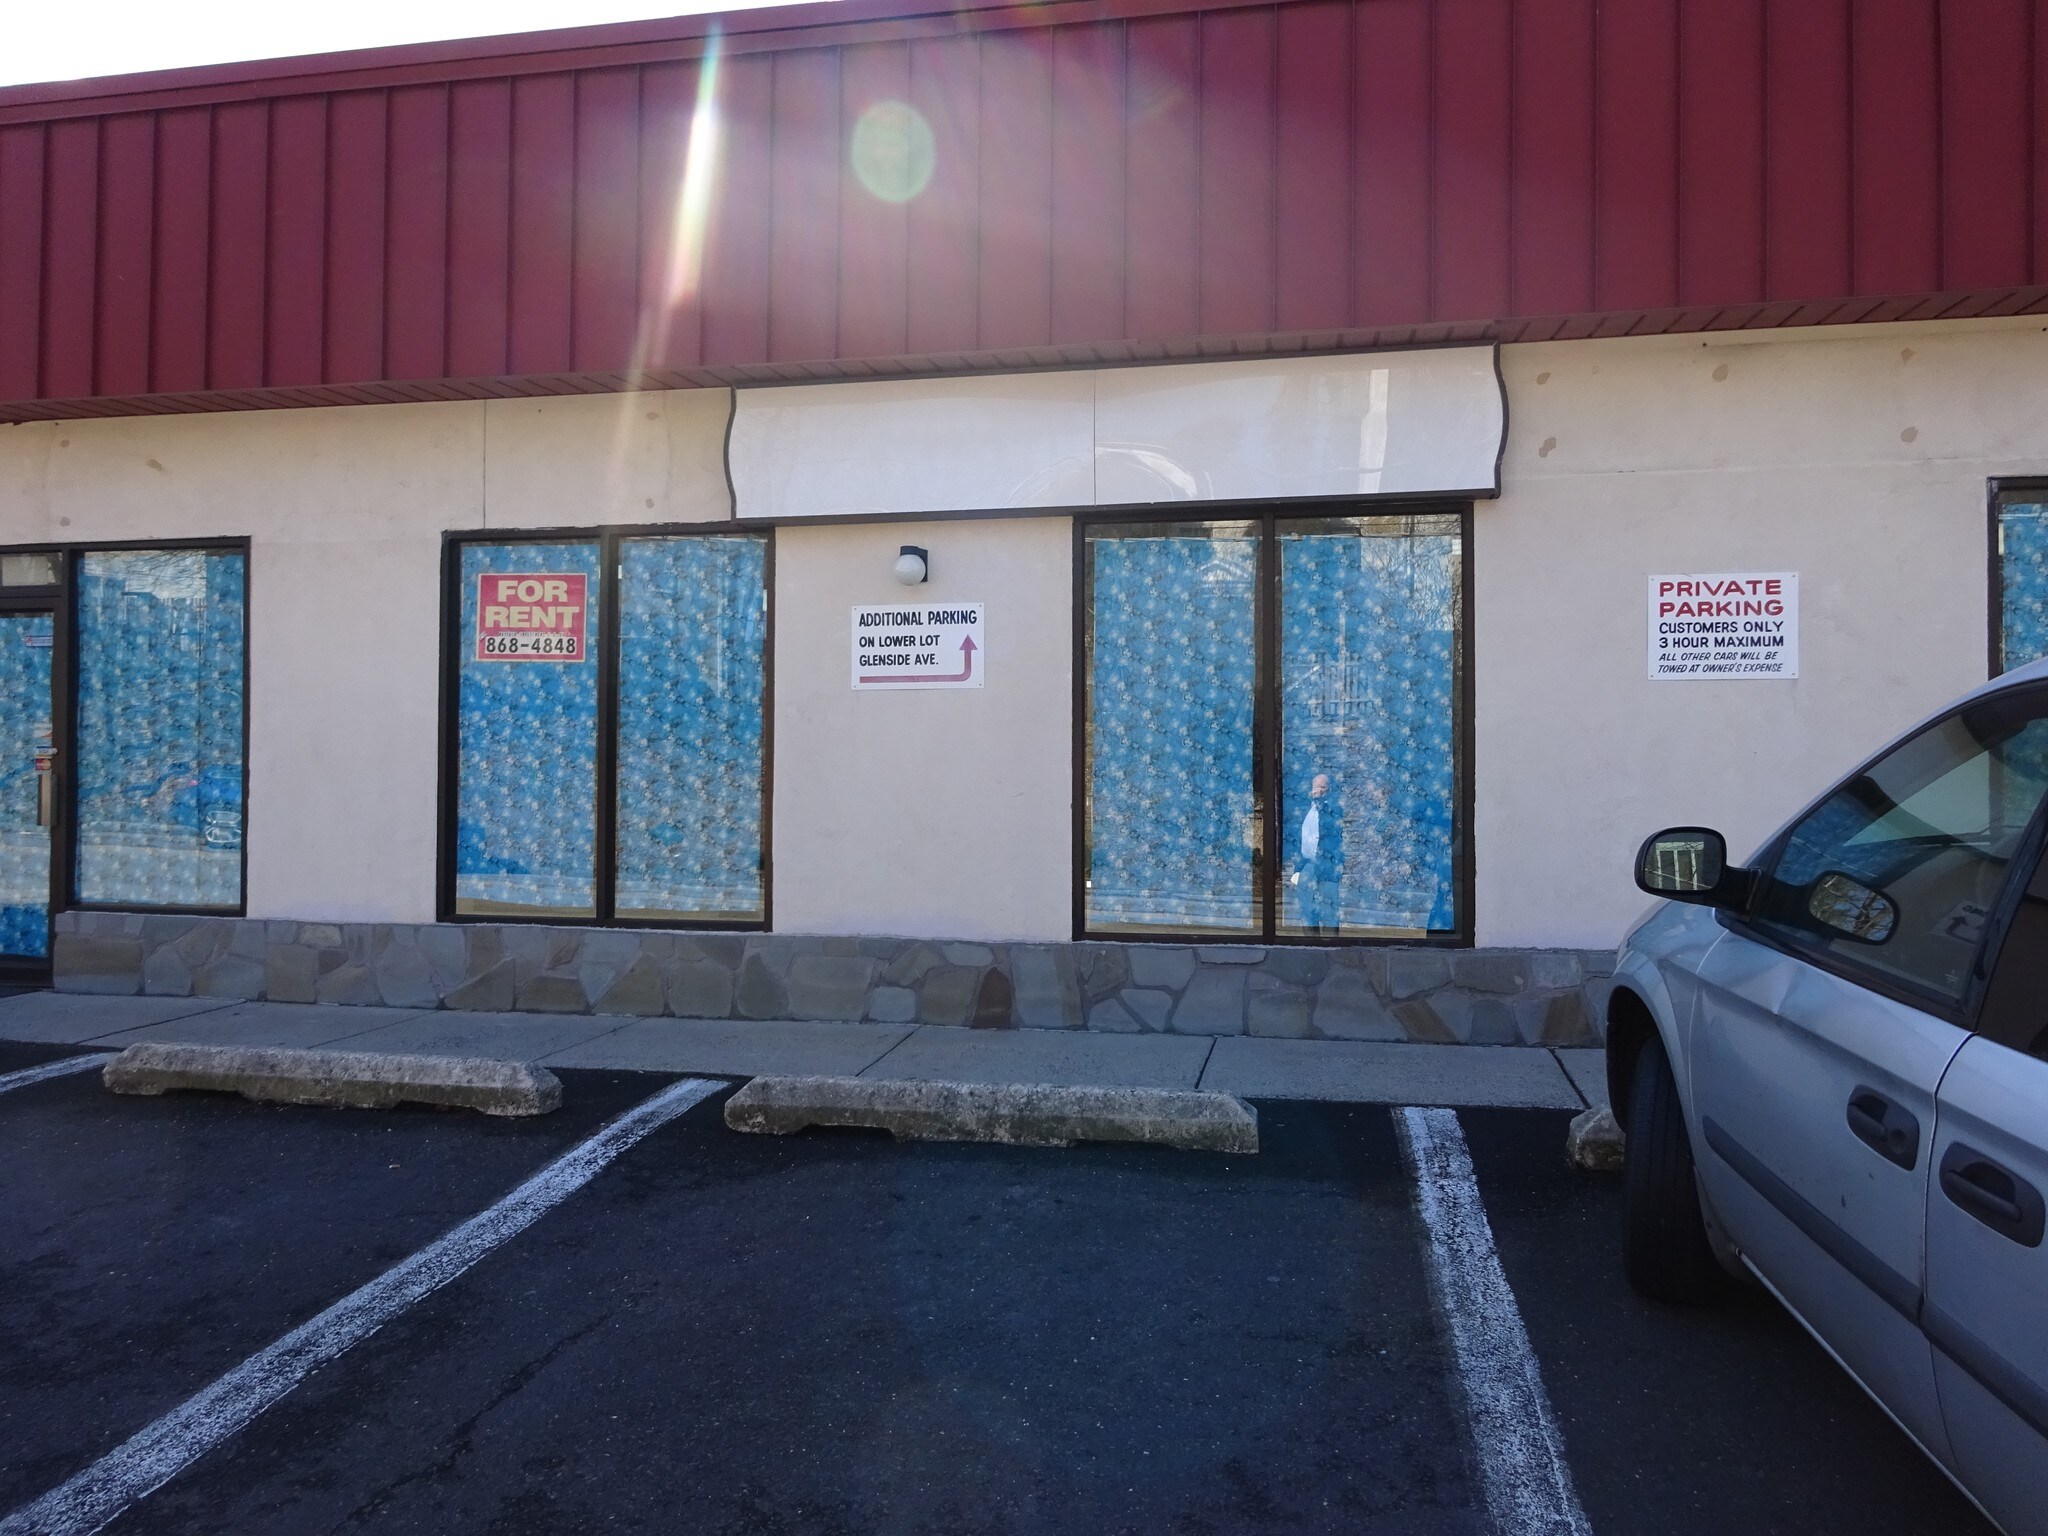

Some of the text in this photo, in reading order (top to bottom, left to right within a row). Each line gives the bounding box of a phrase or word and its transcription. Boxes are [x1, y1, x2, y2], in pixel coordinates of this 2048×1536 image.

[497, 580, 568, 603] FOR
[1659, 579, 1782, 597] PRIVATE
[1659, 599, 1784, 618] PARKING
[485, 606, 580, 628] RENT
[859, 610, 978, 627] ADDITIONAL PARKING
[1659, 620, 1784, 634] CUSTOMERS ONLY
[486, 637, 576, 654] 868-4848
[859, 635, 940, 648] ON LOWER LOT
[1658, 635, 1784, 649] 3 HOUR MAXIMUM
[859, 653, 939, 666] GLENSIDE AVE.
[1658, 651, 1778, 661] ALL OTHER CARS WILL BE
[1657, 662, 1783, 673] TOWED AT OWNER'S EXPENSE
